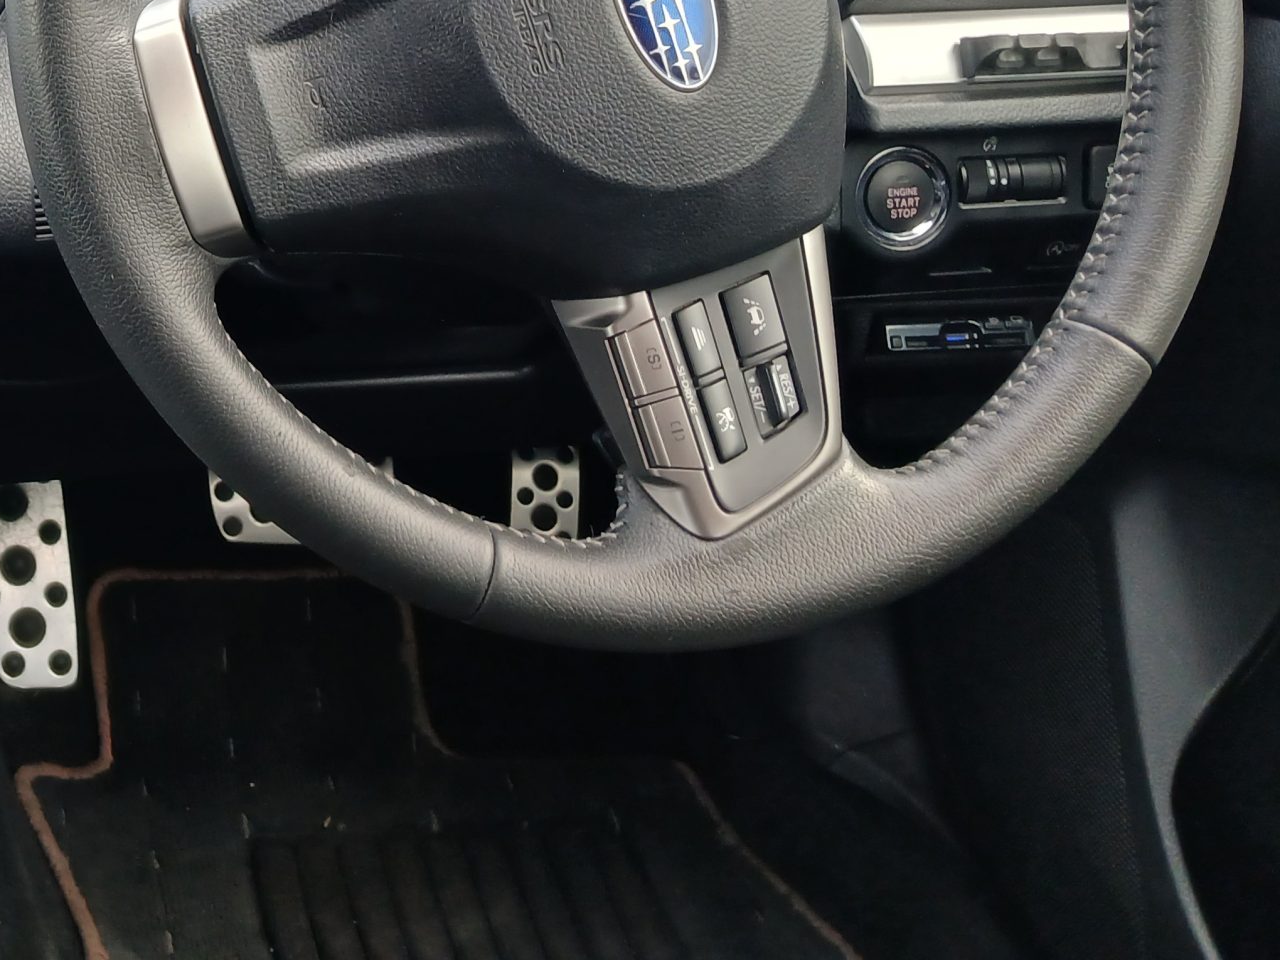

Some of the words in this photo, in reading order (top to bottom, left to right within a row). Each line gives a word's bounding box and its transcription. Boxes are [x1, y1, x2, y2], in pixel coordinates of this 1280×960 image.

[887, 186, 918, 197] ENGINE
[886, 196, 920, 209] START
[890, 207, 918, 219] STOP
[676, 365, 698, 415] SI-DRIVE
